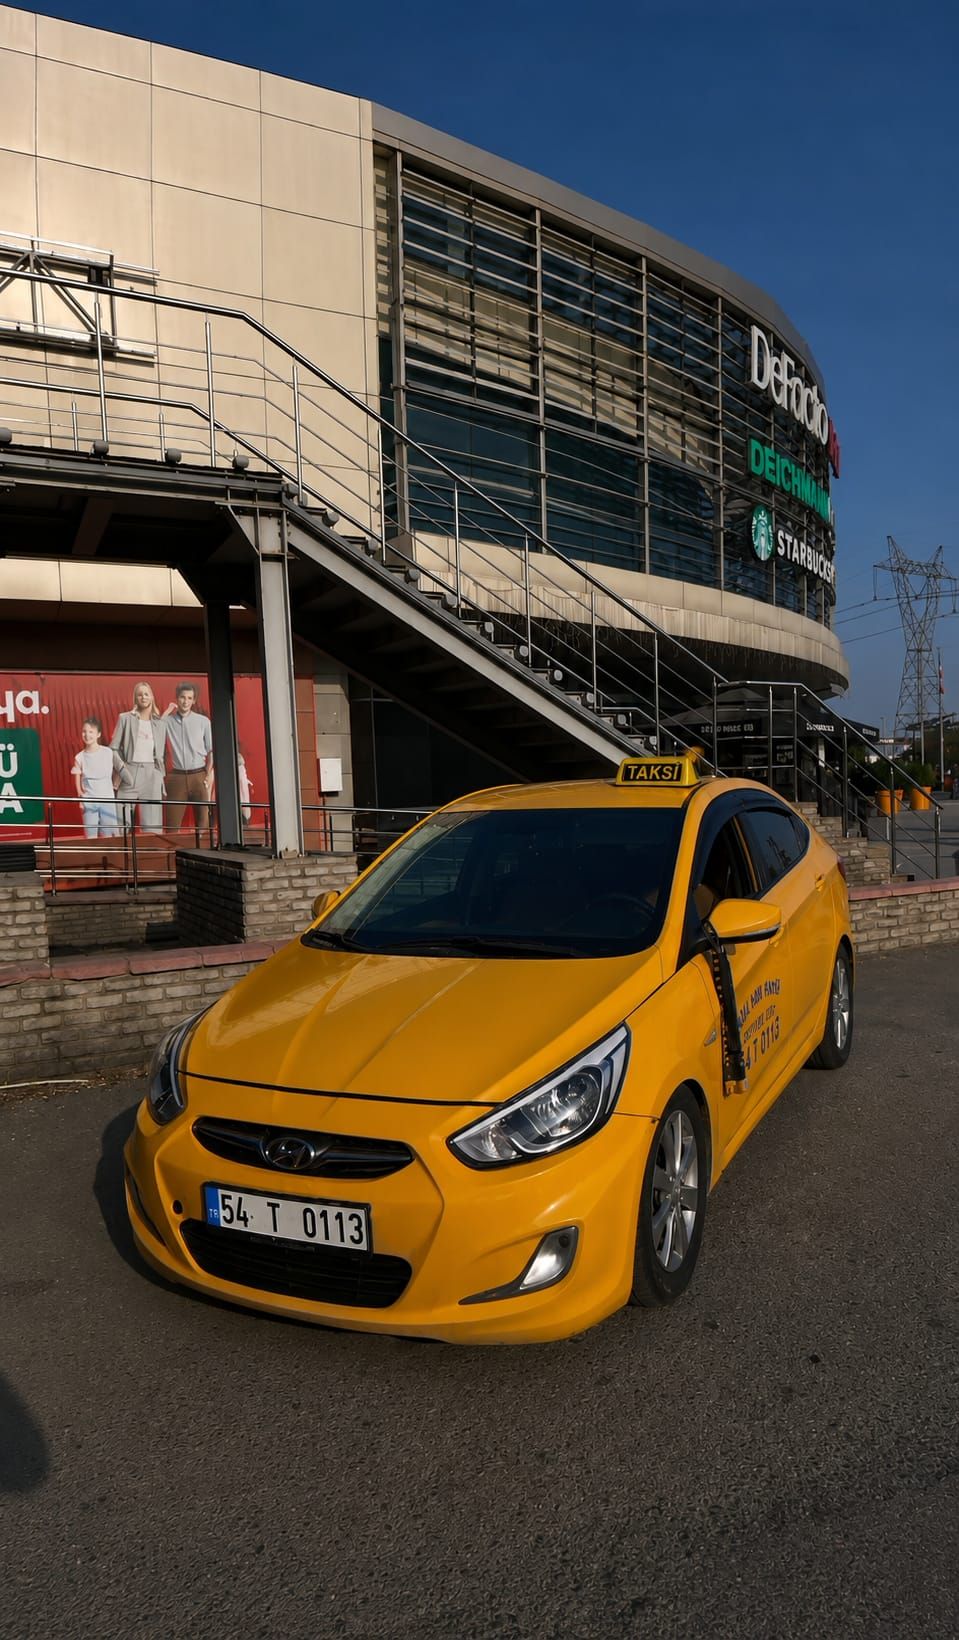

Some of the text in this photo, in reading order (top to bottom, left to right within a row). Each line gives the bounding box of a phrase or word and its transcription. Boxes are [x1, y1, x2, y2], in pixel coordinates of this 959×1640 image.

[750, 325, 829, 446] DeFacto
[777, 529, 832, 584] STARBUCKS
[627, 762, 680, 780] TAKSİ
[761, 1016, 780, 1055] 0113
[220, 1194, 364, 1245] 54 T 0113
